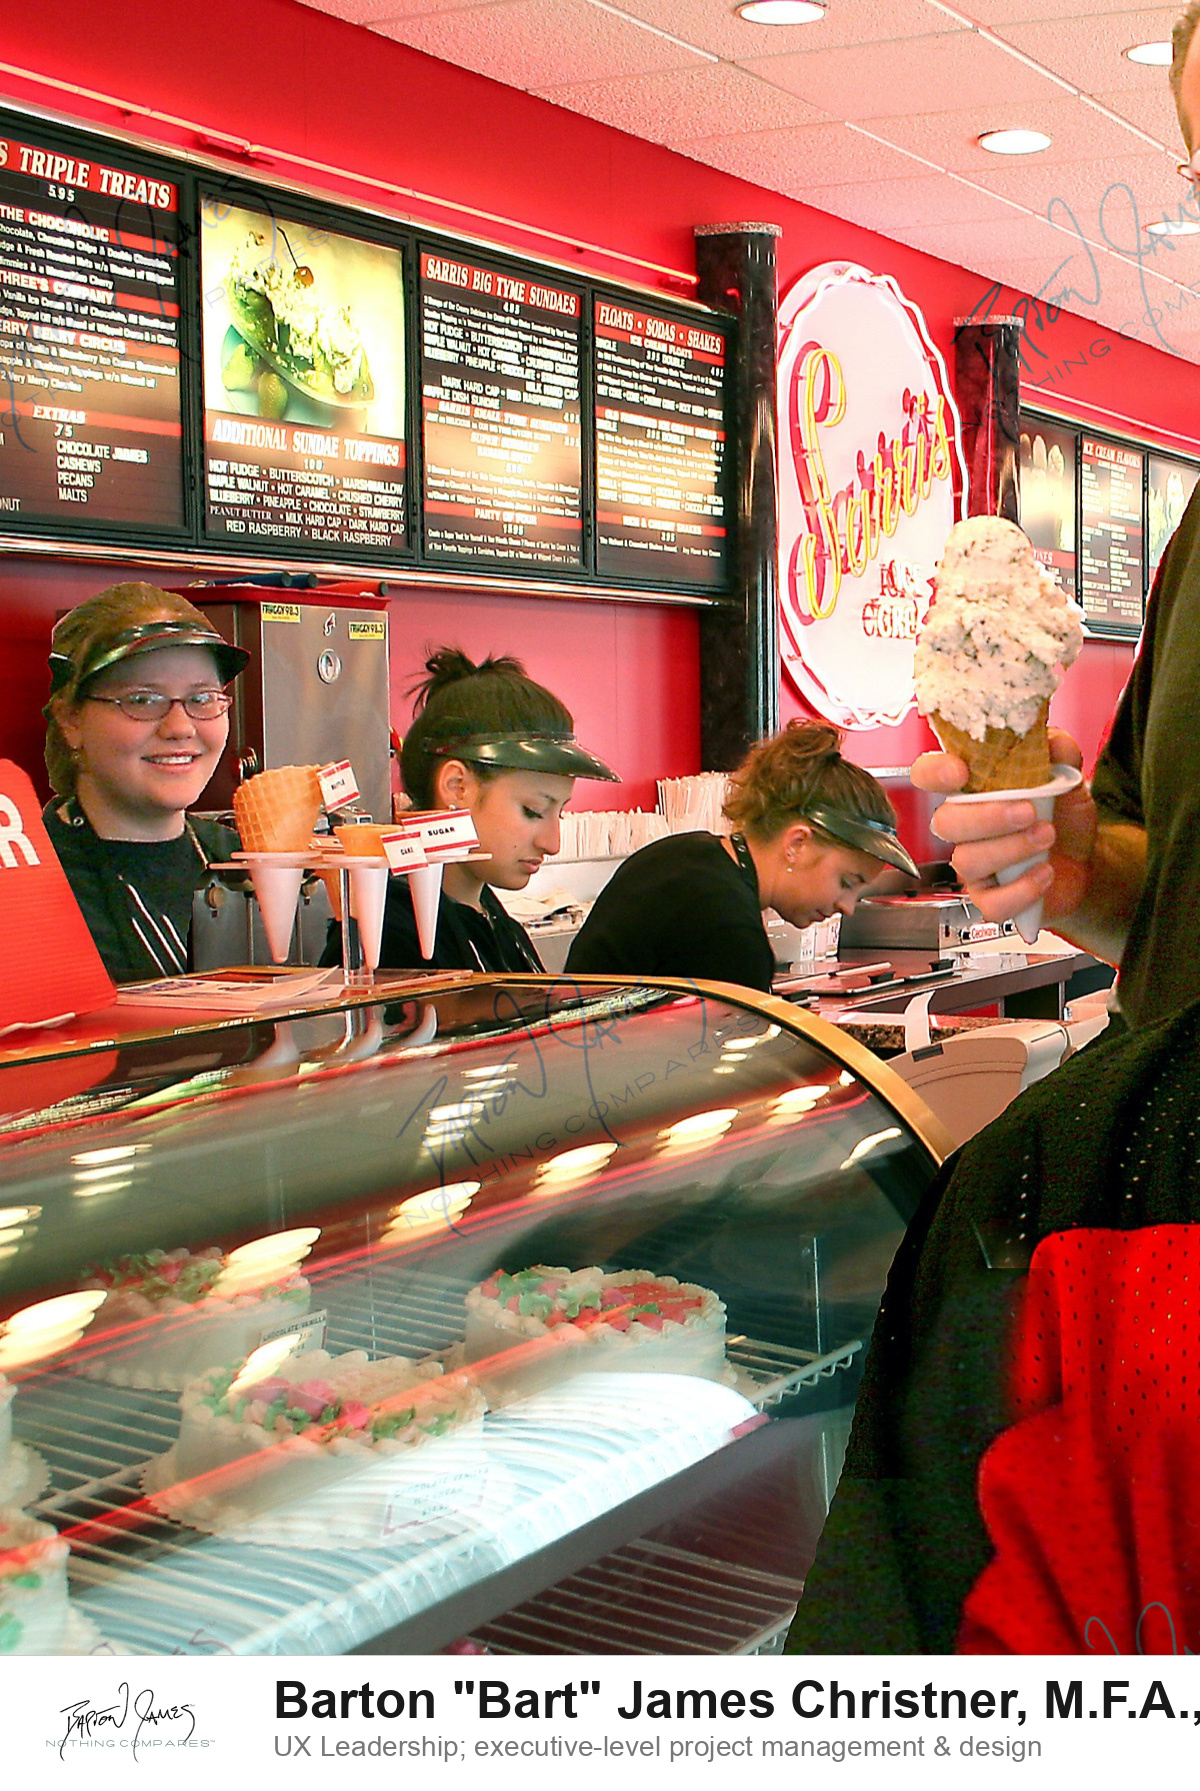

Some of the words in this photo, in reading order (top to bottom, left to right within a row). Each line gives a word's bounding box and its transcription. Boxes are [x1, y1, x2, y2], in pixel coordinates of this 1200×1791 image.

[20, 148, 90, 188] TRIPLE
[100, 169, 170, 210] TREATS
[0, 206, 24, 223] THE
[29, 212, 109, 243] CHOCOHOLIC
[0, 272, 49, 292] THREE'S
[53, 281, 114, 305] COMPANY
[427, 258, 468, 288] SARRIS
[473, 270, 492, 294] BIG
[497, 276, 526, 304] TYME
[529, 286, 575, 316] SUNDAES
[80, 334, 126, 354] CIRCUS
[600, 306, 634, 332] FLOATS
[646, 318, 675, 343] SODAS
[687, 329, 721, 355] SHAKES
[33, 406, 86, 425] EXTRAS
[57, 440, 110, 459] CHOCOLATE
[212, 419, 287, 451] ADDITIONAL
[292, 431, 339, 459] SUNDAE
[344, 439, 399, 467] TOPPINGS
[1083, 441, 1094, 455] ICE
[1095, 445, 1115, 461] CREAM
[57, 456, 102, 474] CASHEWS
[209, 460, 229, 474] HOT
[230, 463, 260, 478] FUDGE
[269, 468, 335, 487] BUTTERSCOTCH
[343, 478, 404, 496] MARSHMALLOW
[58, 472, 94, 489] PECANS
[59, 488, 88, 503] MALTS
[208, 474, 236, 489] MAPLE
[238, 478, 269, 493] WALNUT
[278, 483, 293, 496] HOT
[295, 485, 330, 500] CARAMEL
[338, 491, 372, 505] CRUSHED
[374, 495, 403, 509] CHERRY
[788, 341, 951, 625] Sarris
[210, 489, 255, 506] BLUEBERRY
[263, 496, 301, 511] PINEAPPLE
[309, 501, 352, 516] CHOCOLATE
[359, 506, 404, 522] STRAWBERRY
[210, 505, 241, 517] PEANUT
[242, 509, 272, 521] BUTTER
[286, 513, 304, 525] MILK
[306, 515, 325, 527] HARD
[327, 517, 341, 529] CAP
[349, 520, 368, 531] DARK
[370, 522, 389, 534] HARD
[391, 524, 404, 535] CAP
[475, 508, 501, 521] PARTY
[226, 520, 245, 533] RED
[249, 522, 301, 539] RASPBERRY
[312, 529, 339, 543] BLACK
[343, 532, 392, 548] RASPBERRY
[427, 826, 456, 837] SUGAR
